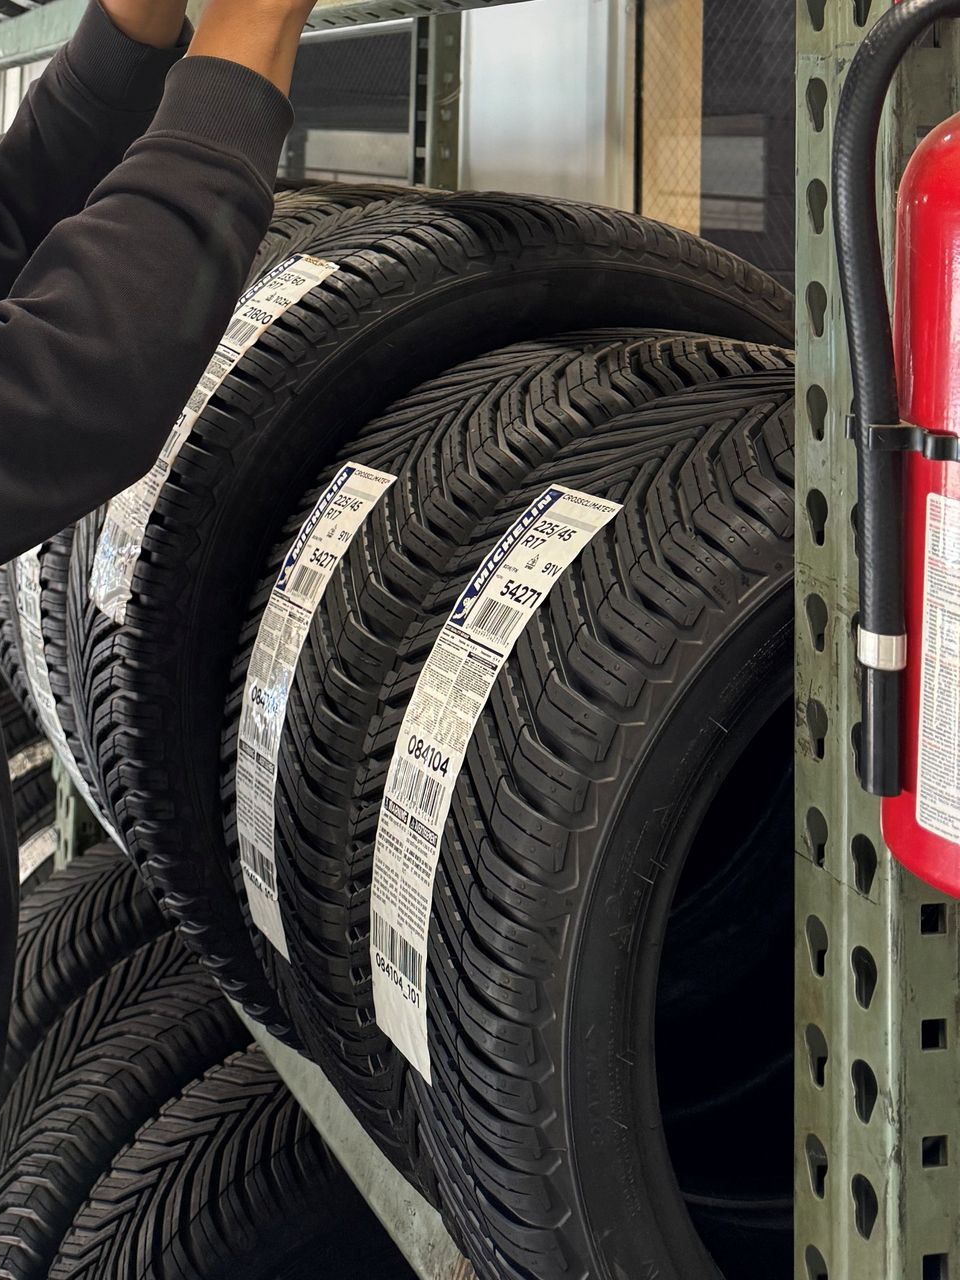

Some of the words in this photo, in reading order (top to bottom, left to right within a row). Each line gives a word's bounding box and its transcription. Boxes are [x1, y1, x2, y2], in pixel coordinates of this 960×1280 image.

[240, 257, 295, 306] ICHELIN
[243, 307, 273, 325] 21800
[333, 494, 363, 512] 225/45
[292, 470, 348, 560] MICHELIN
[325, 508, 342, 521] R17
[338, 530, 352, 543] 91V
[533, 520, 577, 542] 225/45
[473, 494, 552, 592] MICHELIN
[521, 535, 547, 550] R17
[309, 548, 338, 571] 54271
[541, 562, 562, 577] 91V
[500, 579, 542, 608] 54271
[407, 734, 450, 777] 084104
[375, 952, 421, 1008] 084104_101
